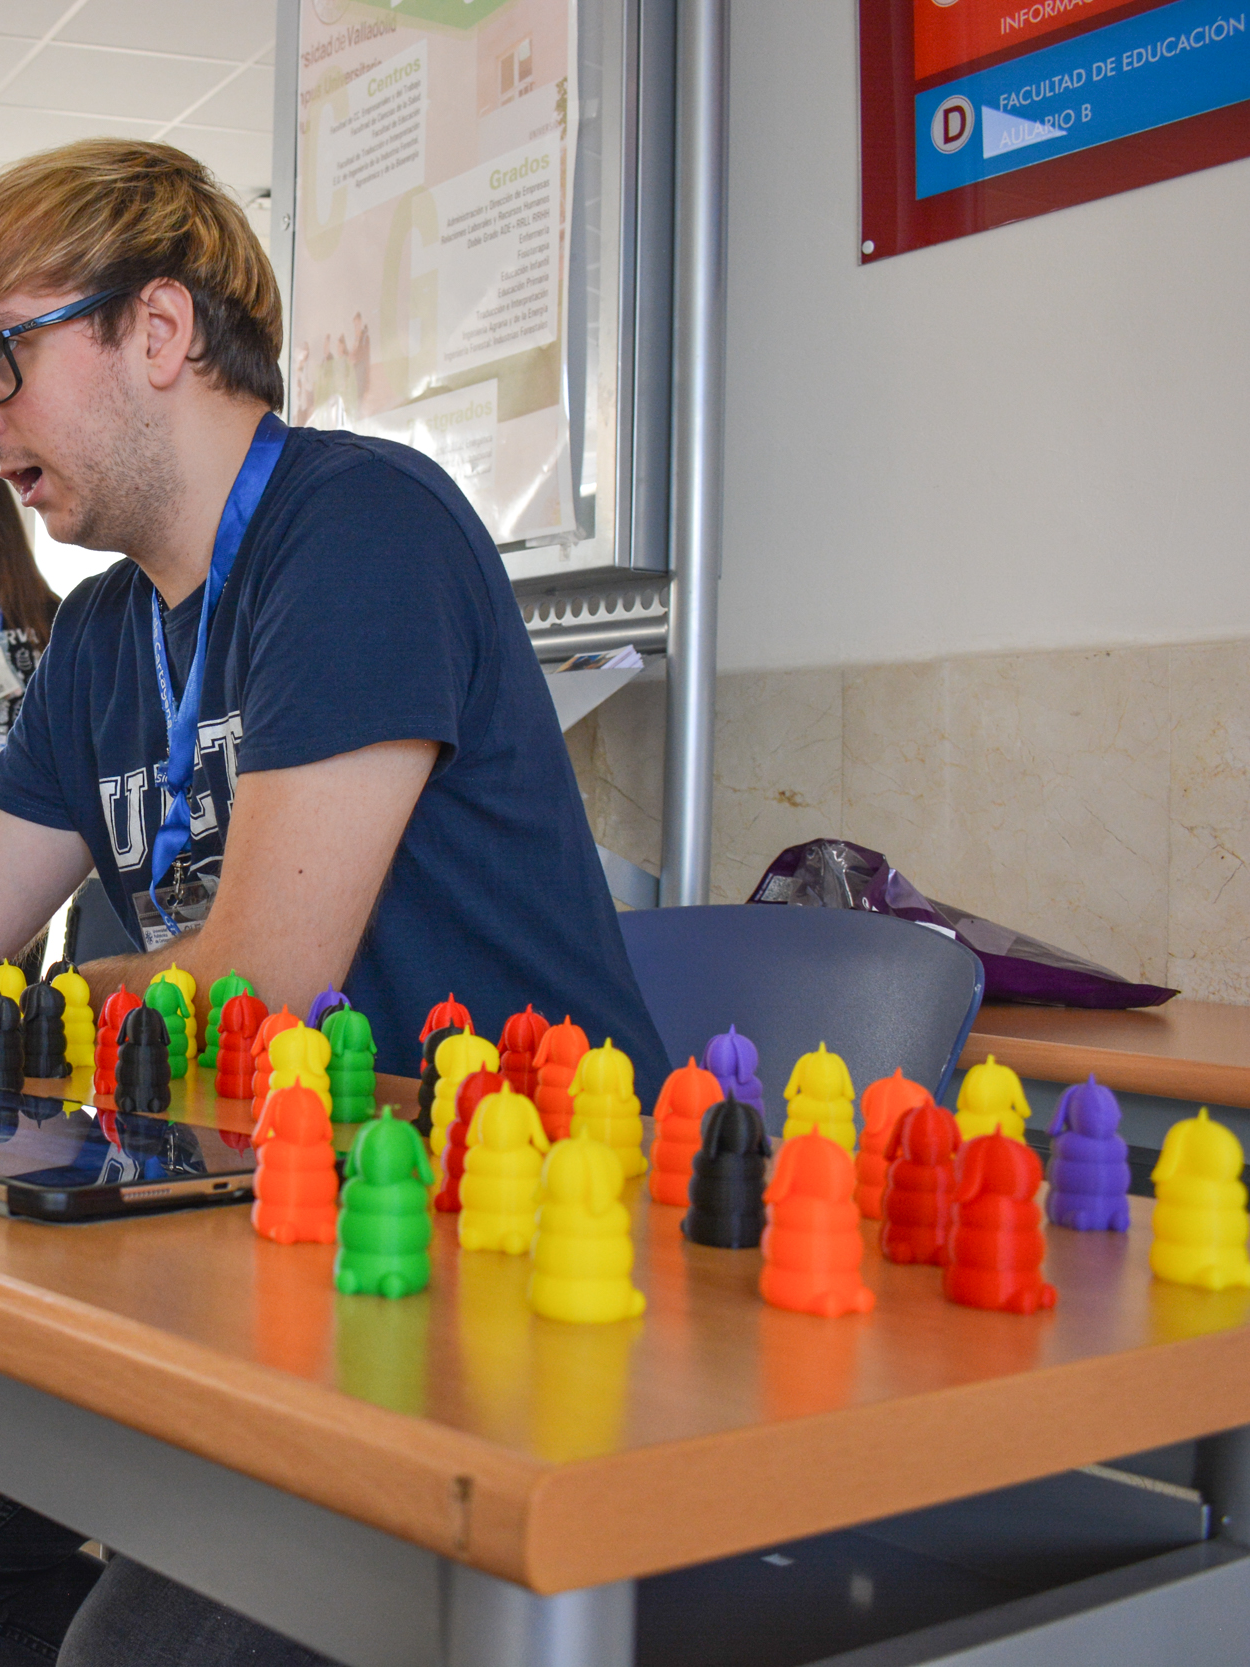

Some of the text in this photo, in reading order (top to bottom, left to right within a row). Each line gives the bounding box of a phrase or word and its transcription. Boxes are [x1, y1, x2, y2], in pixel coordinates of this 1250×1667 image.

[347, 11, 396, 47] Valladolid
[1000, 0, 1097, 35] INFORMA
[367, 58, 421, 97] Centros
[999, 13, 1246, 112] FACULTAD DE EDUCACIÓN
[943, 104, 967, 145] D
[999, 103, 1092, 149] AULARIO B
[489, 153, 550, 191] Grados
[154, 642, 173, 729] Cartagena
